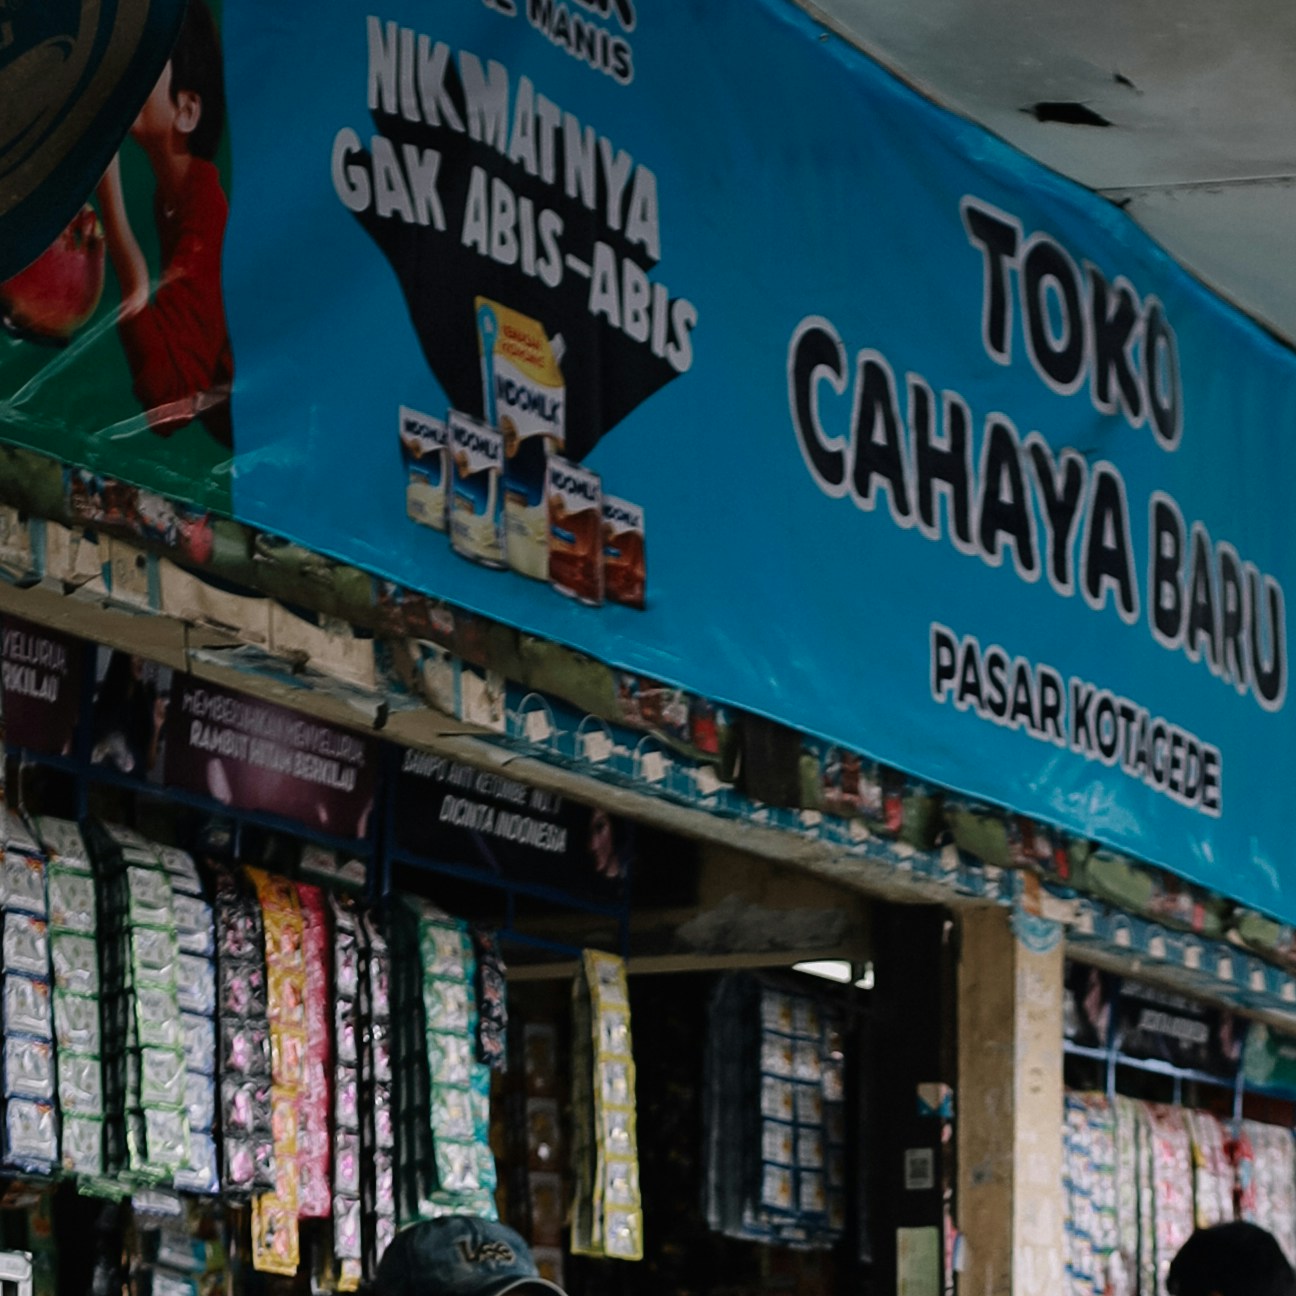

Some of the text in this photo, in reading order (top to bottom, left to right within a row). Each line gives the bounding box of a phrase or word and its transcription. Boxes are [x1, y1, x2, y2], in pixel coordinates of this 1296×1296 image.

[331, 127, 698, 373] GAK ABIS-ABIS
[367, 14, 661, 261] NIKMATNYA
[960, 195, 1183, 452] TOKO
[787, 315, 1287, 713] CAHAYA BARU
[929, 621, 1222, 818] PASAR KOTAGEDE
